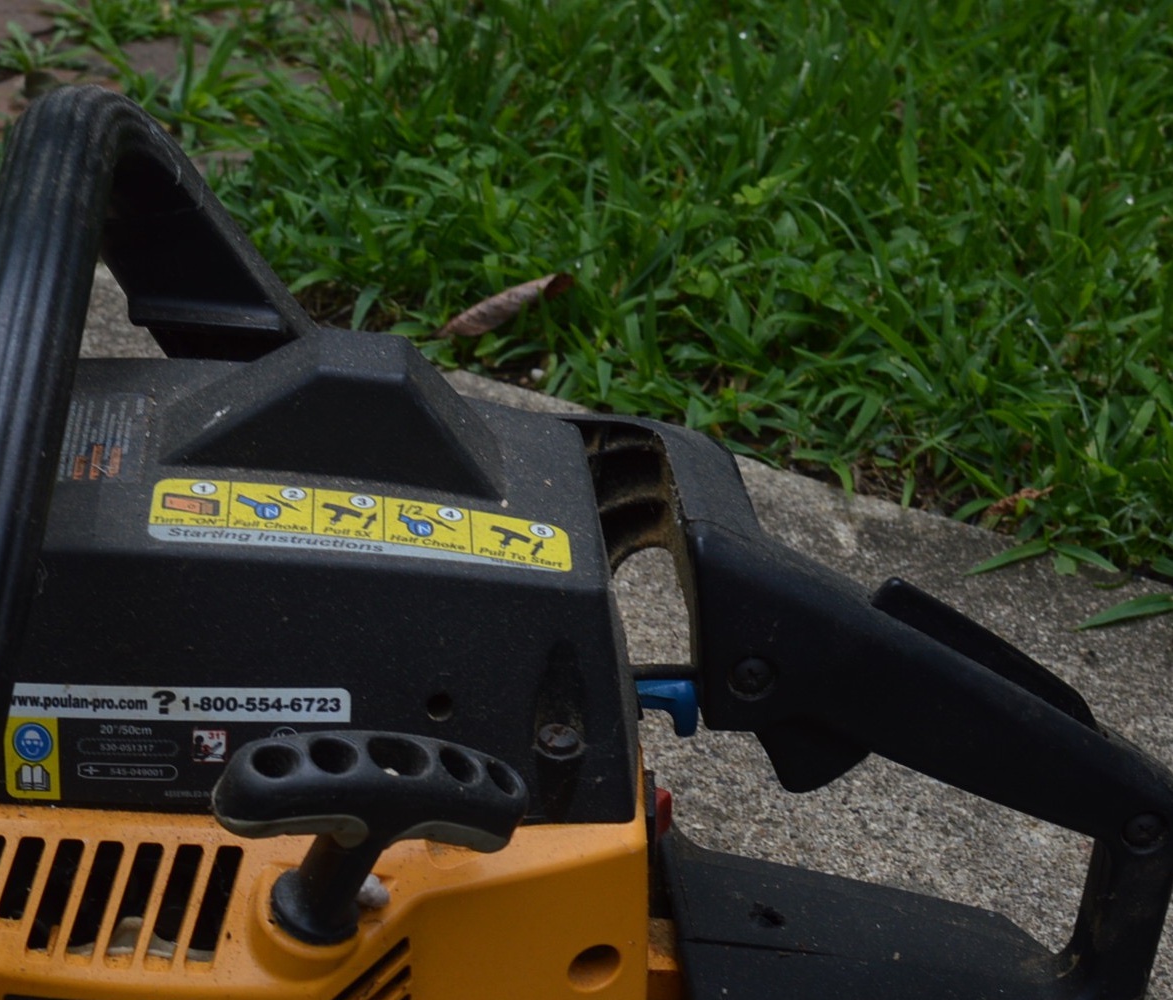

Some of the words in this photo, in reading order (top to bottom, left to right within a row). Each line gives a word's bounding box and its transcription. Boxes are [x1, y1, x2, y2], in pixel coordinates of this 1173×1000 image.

[397, 504, 422, 515] 1/2
[154, 516, 184, 525] Turn
[264, 521, 308, 532] Choke
[323, 527, 351, 537] Pull
[356, 530, 371, 538] 5X
[168, 527, 251, 542] Starting
[257, 532, 384, 553] Instructions
[390, 534, 418, 544] Half
[422, 538, 466, 551] Choke
[479, 547, 505, 558] Pull
[510, 552, 527, 562] To
[531, 556, 563, 568] Start
[181, 697, 341, 712] 1-800-554-6723
